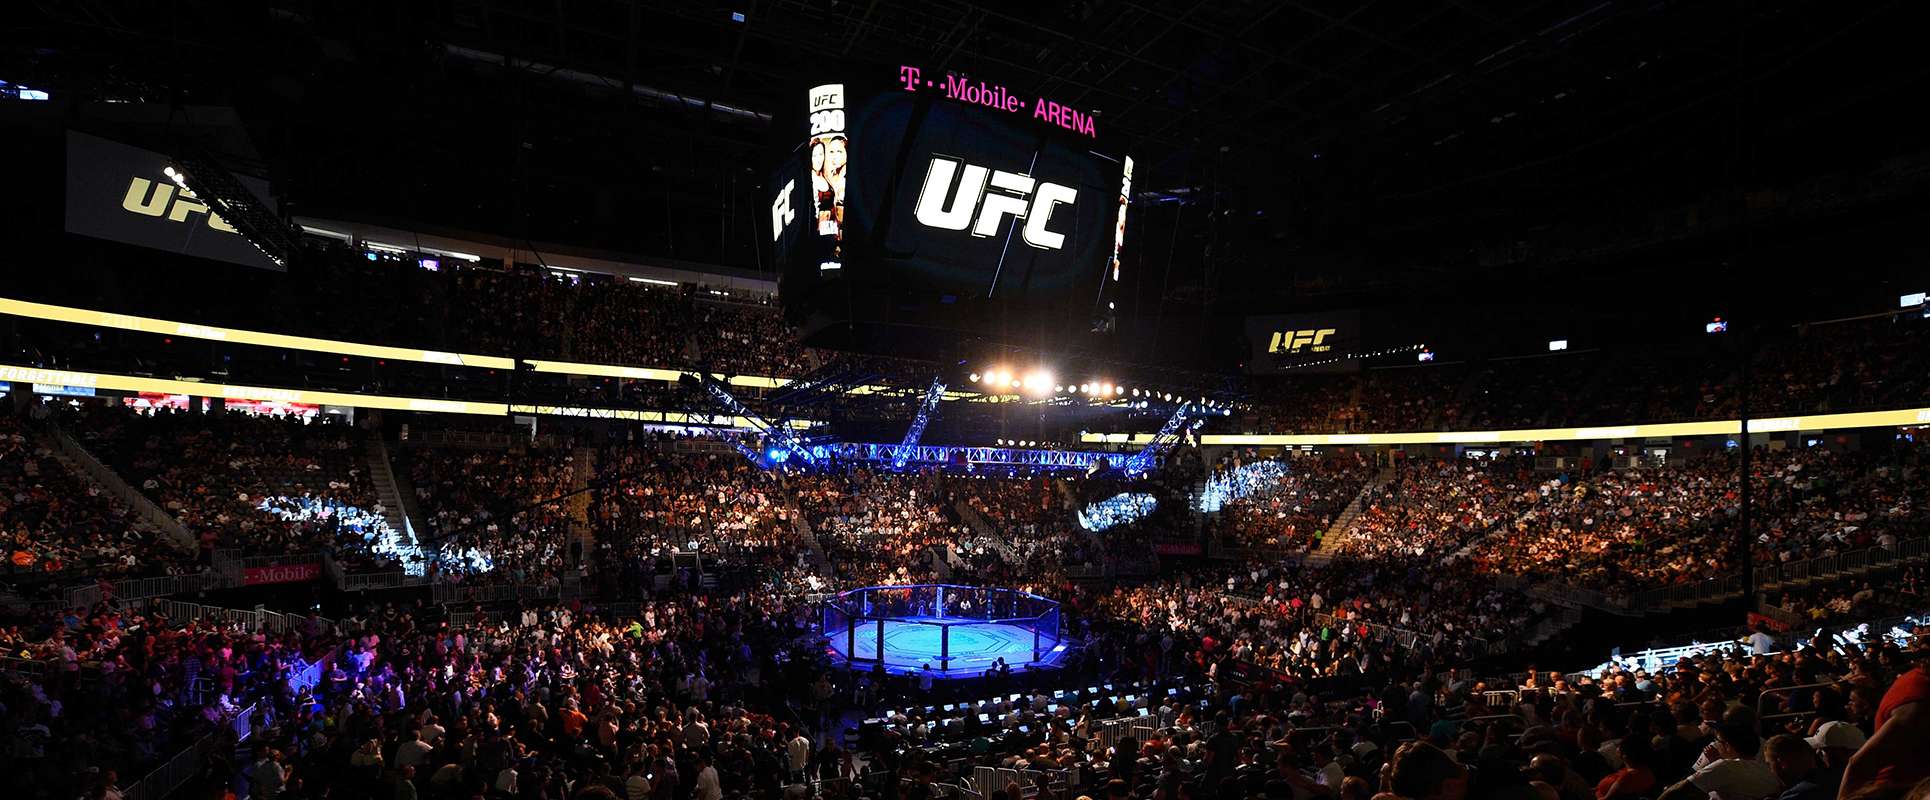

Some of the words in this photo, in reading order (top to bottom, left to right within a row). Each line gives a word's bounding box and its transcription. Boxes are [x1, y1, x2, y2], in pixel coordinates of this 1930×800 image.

[814, 93, 838, 107] UFC
[1033, 98, 1096, 138] ARENA
[810, 110, 845, 136] 200
[122, 176, 239, 234] UF
[914, 155, 1078, 250] UFC
